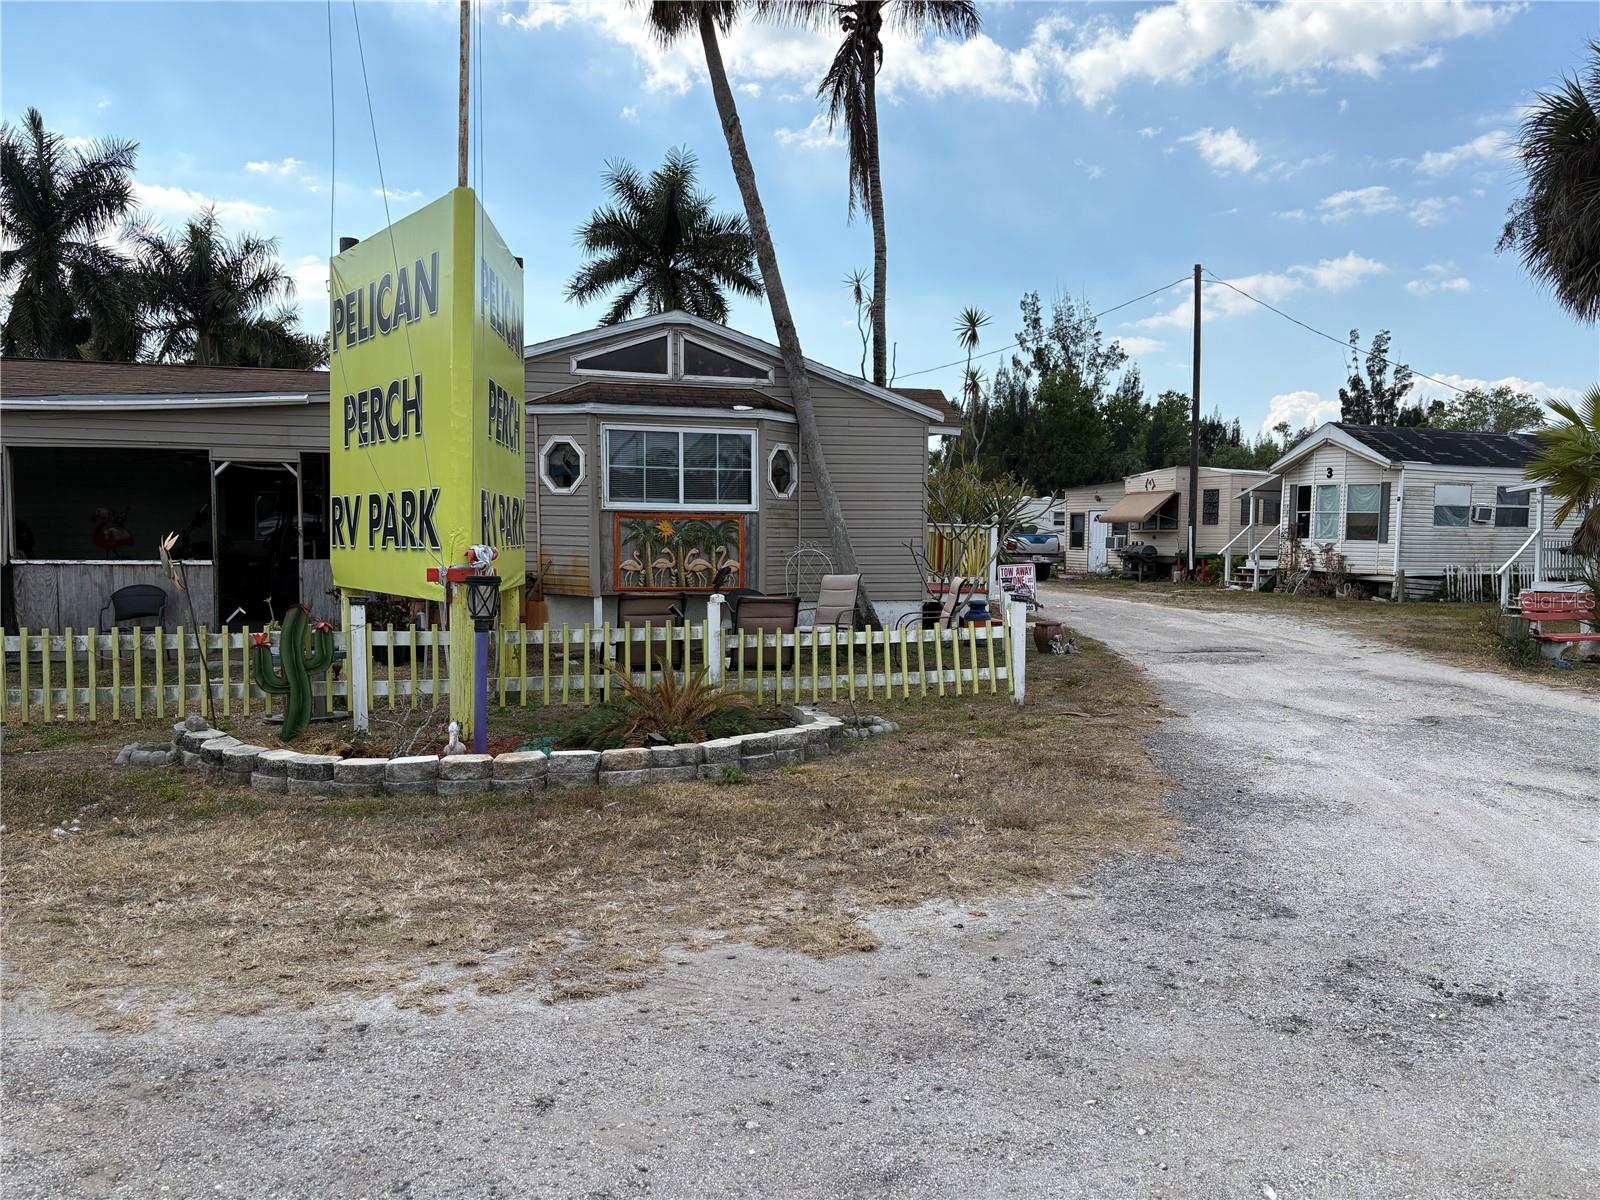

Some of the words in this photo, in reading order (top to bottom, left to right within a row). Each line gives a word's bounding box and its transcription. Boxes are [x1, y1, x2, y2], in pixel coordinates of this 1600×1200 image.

[333, 250, 440, 352] PELICAN
[481, 257, 524, 362] PELICAN
[344, 373, 423, 449] PERCH
[488, 377, 521, 455] PERCH
[1326, 467, 1333, 478] 3
[332, 493, 362, 549] RV
[368, 487, 441, 550] PARK
[481, 489, 498, 549] RV
[499, 494, 526, 550] PARK
[1001, 568, 1013, 576] TOW
[1016, 567, 1032, 576] AWAY
